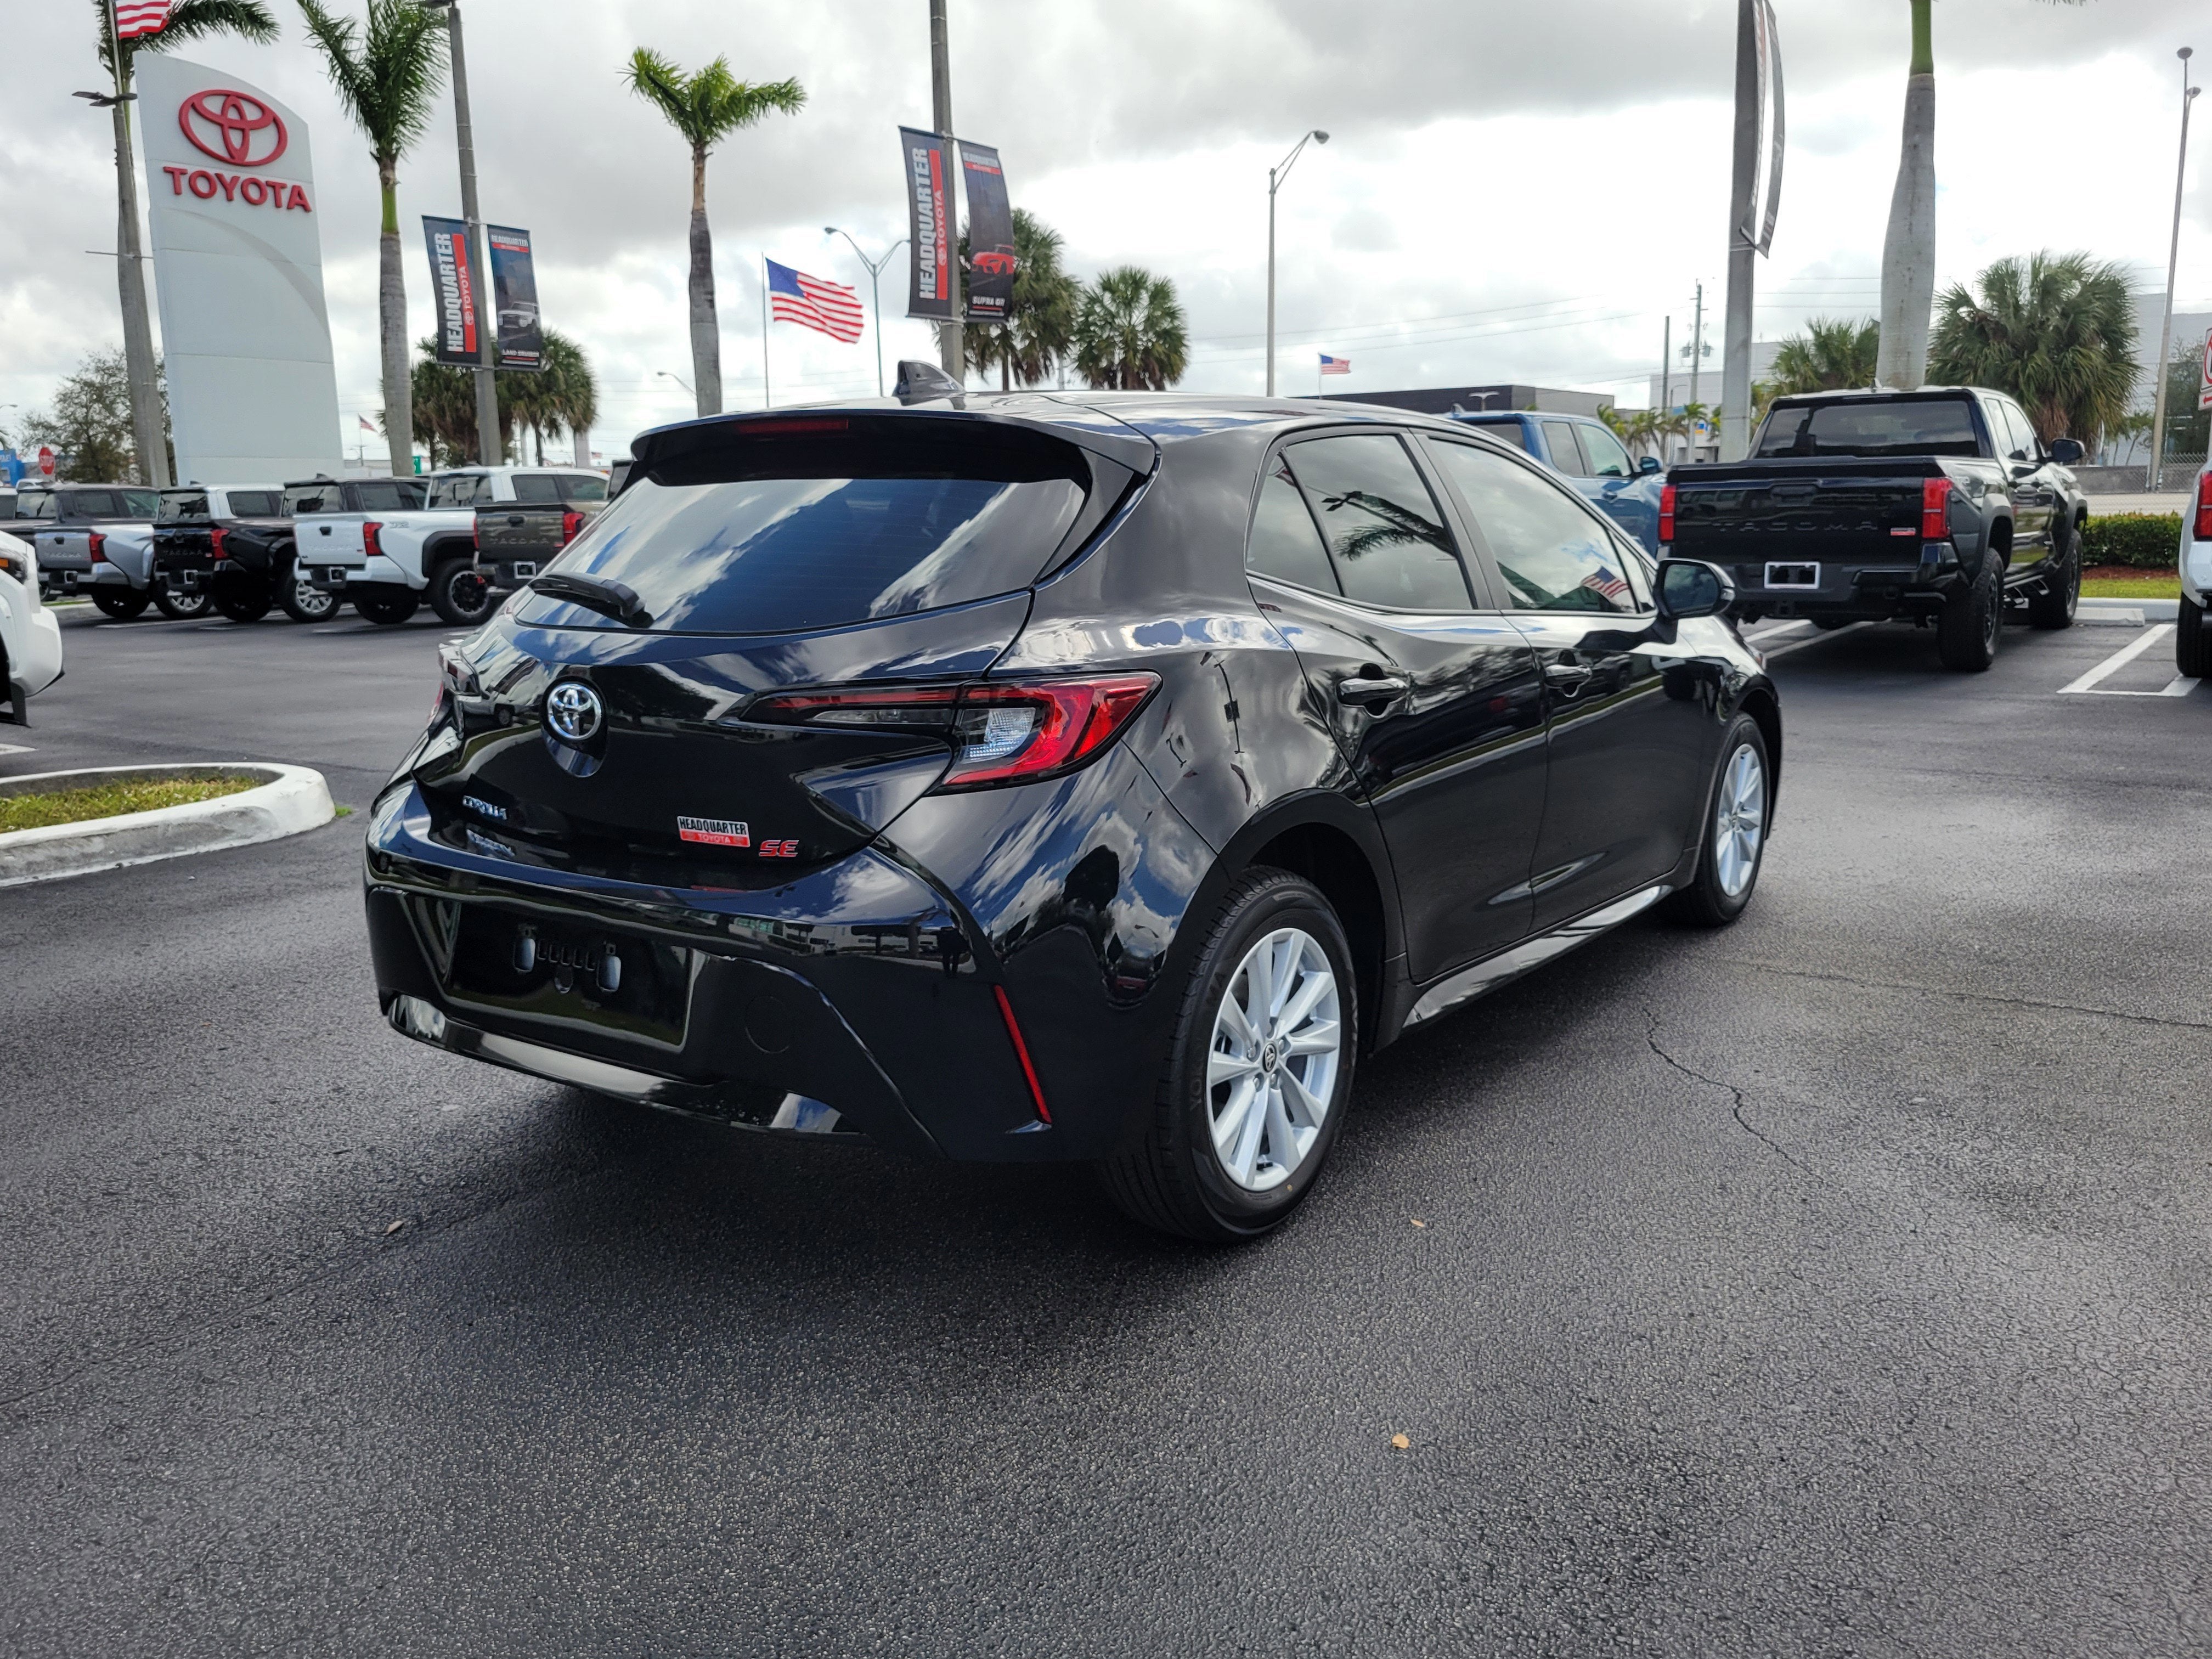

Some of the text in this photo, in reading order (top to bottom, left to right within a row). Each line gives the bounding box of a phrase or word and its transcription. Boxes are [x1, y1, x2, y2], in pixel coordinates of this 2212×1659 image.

[163, 166, 312, 212] TOYOTA
[912, 148, 936, 300] HEADQUARTER
[934, 190, 945, 245] TOYOTA
[435, 233, 464, 352] HEADQUARTER
[459, 266, 471, 309] TOYOTA
[1712, 521, 1878, 532] TACOMA
[679, 817, 747, 835] HEADQUARTER
[698, 833, 731, 844] TOYOTA
[759, 839, 800, 857] SE
